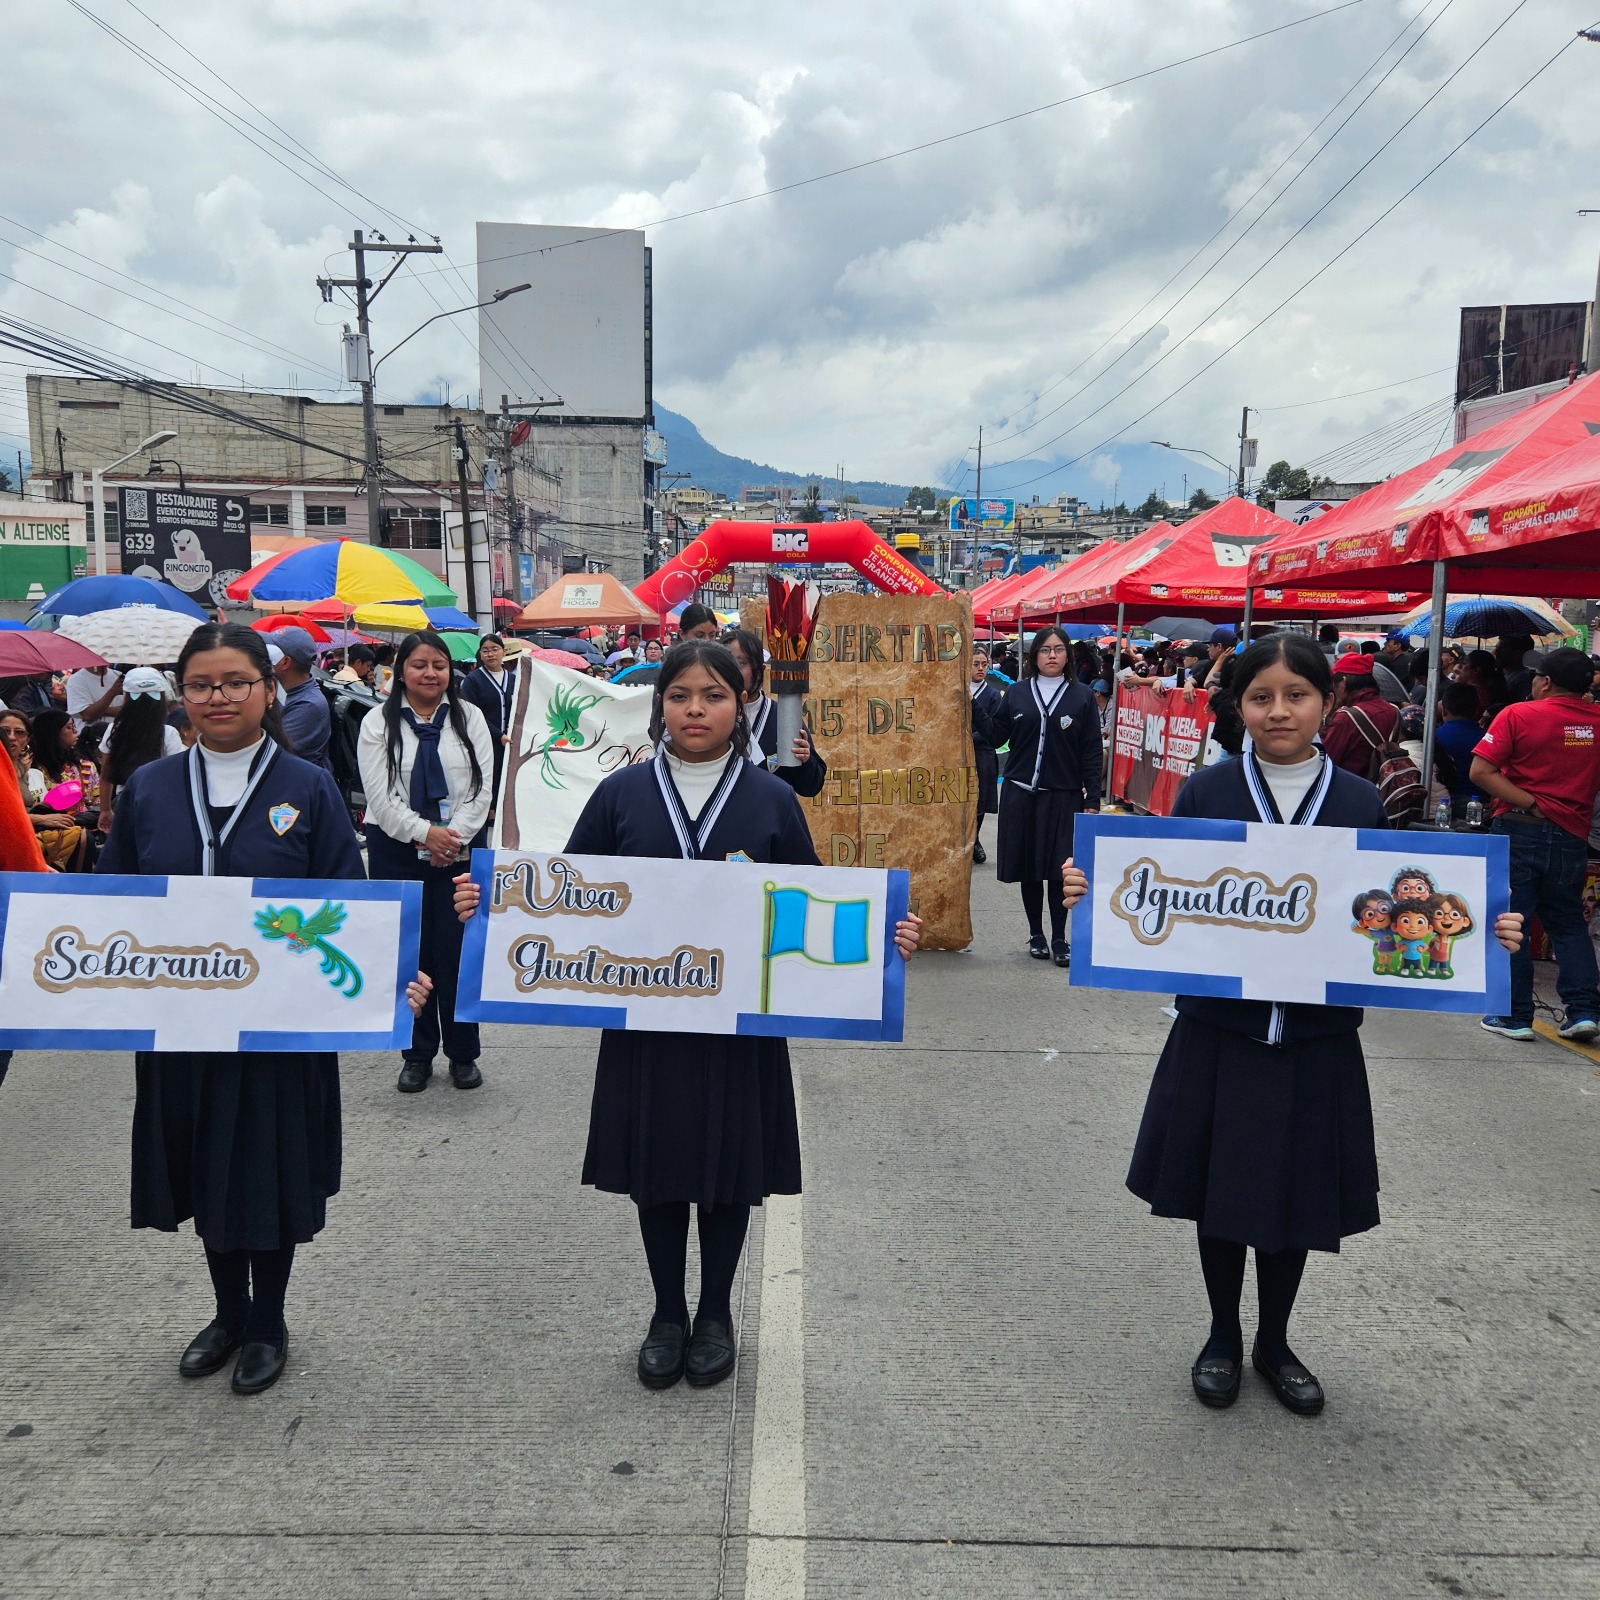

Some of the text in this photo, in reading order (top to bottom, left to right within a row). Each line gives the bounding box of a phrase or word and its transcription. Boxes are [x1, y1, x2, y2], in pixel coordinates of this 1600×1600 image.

[156, 493, 218, 510] RESTAURANTE
[157, 507, 218, 520] EVENTOS PRIVADOS
[1502, 525, 1509, 534] TE
[1509, 520, 1525, 532] HACE
[1544, 507, 1579, 524] GRANDE
[1503, 502, 1546, 521] COMPARTIR
[14, 522, 70, 540] ALTENSE
[1466, 516, 1489, 535] BIG
[125, 533, 155, 550] Q39
[772, 533, 808, 552] BIG
[1392, 529, 1407, 547] BIG
[166, 564, 210, 573] RINCONCITO
[862, 558, 900, 590] GRANDE
[868, 550, 919, 594] TE HACE MÁS
[874, 544, 925, 587] COMPARTIR
[1150, 586, 1168, 595] BIG
[1264, 590, 1283, 600] BIG
[1388, 593, 1408, 602] BIG
[868, 698, 916, 735] DE
[1145, 714, 1166, 755] BIG
[1574, 730, 1594, 738] BIG
[830, 834, 886, 868] DE
[1126, 866, 1310, 936] Igualdad
[515, 940, 718, 988] Guatemala!
